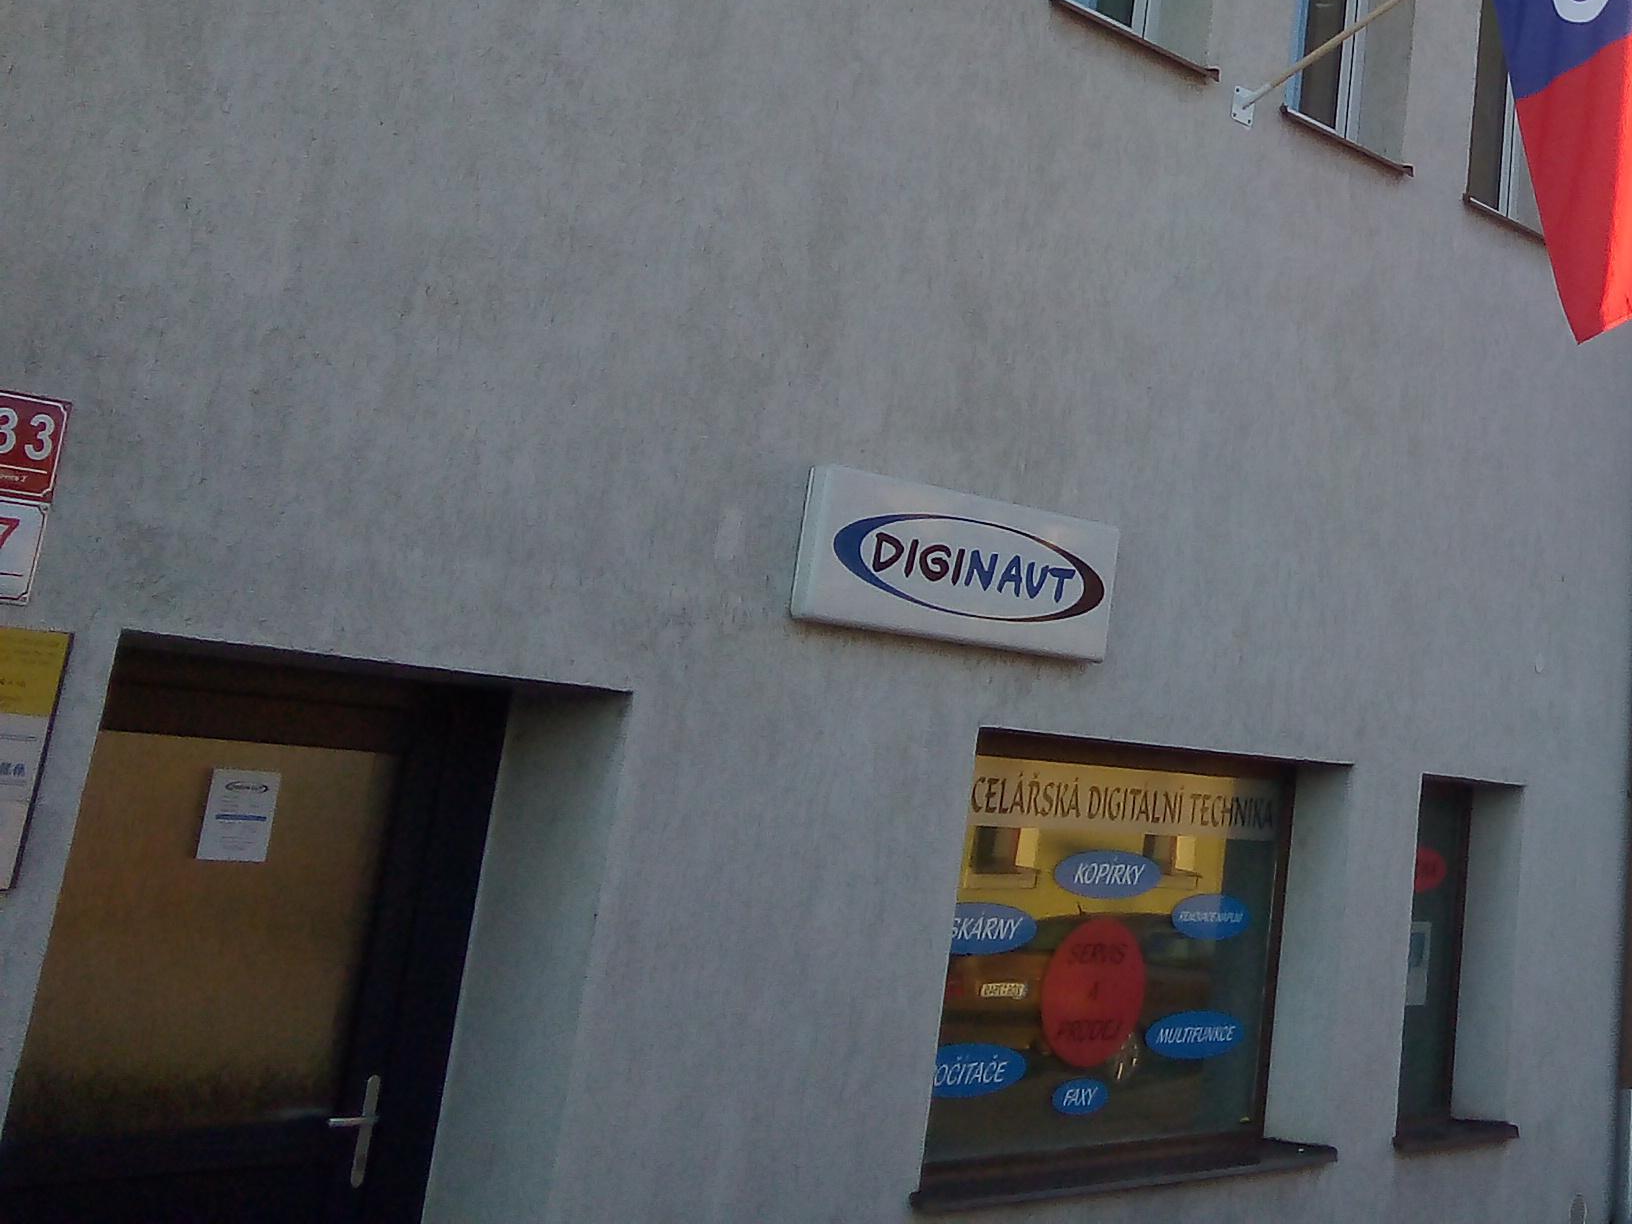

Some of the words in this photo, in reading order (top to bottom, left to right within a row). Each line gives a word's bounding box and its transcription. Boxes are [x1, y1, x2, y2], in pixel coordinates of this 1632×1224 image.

[872, 532, 1076, 603] DIGINAUT
[1087, 782, 1185, 825] DIGITÁLNÍ
[1189, 792, 1274, 829] TECHNIKA
[1073, 855, 1146, 886] KOPÍRKY
[1155, 1025, 1237, 1044] MULTIFUNKCE
[1062, 1086, 1100, 1107] FAXY
